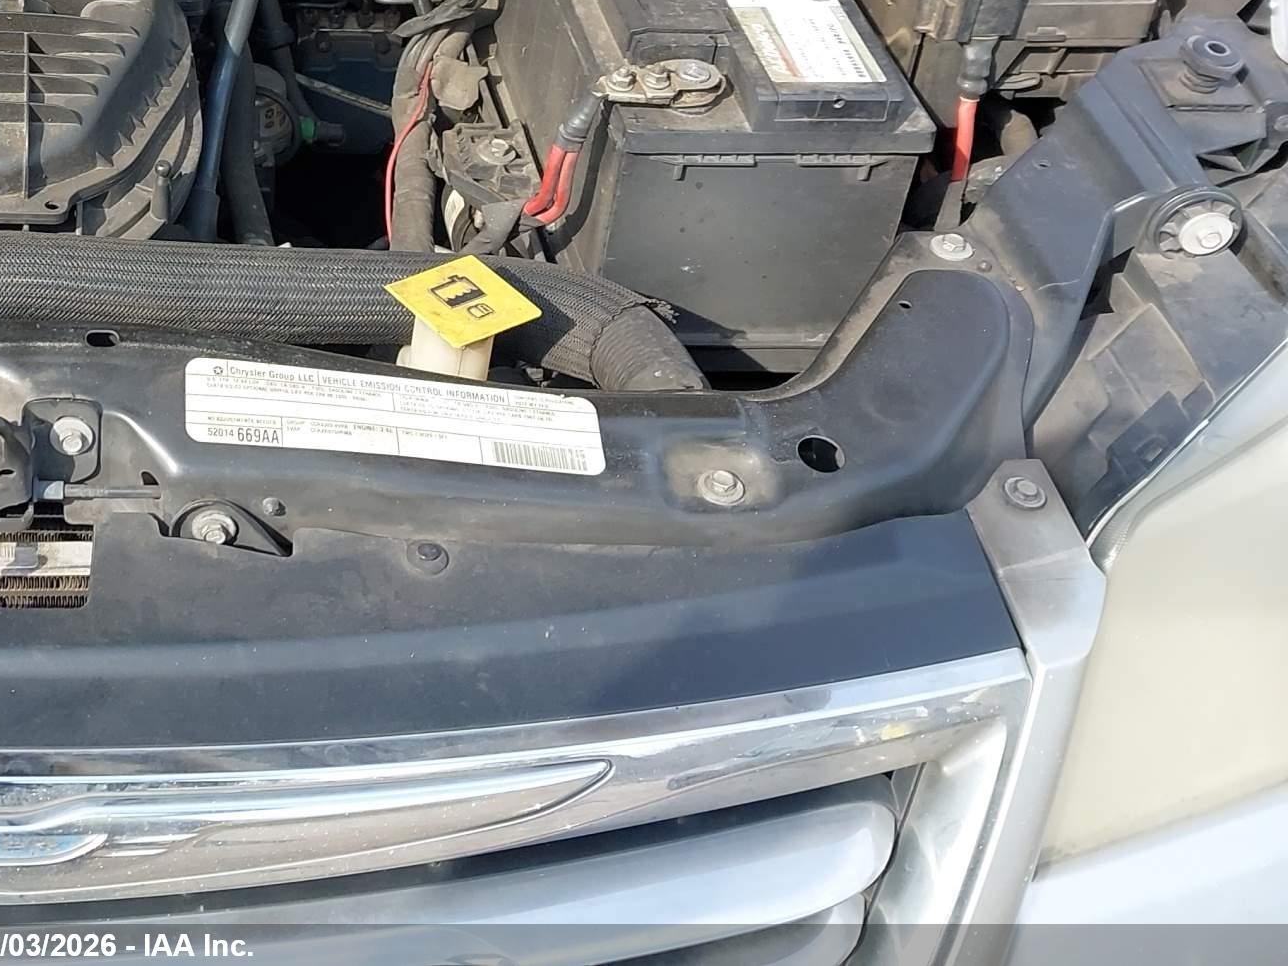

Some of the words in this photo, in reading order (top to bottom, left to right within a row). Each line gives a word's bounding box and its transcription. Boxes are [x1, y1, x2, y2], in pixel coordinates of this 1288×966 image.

[230, 366, 266, 379] Chrysler
[269, 370, 295, 382] Group
[298, 373, 314, 383] LLC
[322, 376, 356, 386] VEHICLE
[360, 379, 401, 392] EMISSION
[404, 385, 442, 397] CONTROL
[446, 389, 506, 403] INFORMATION
[208, 427, 234, 437] 52014
[237, 427, 279, 444] 669AA
